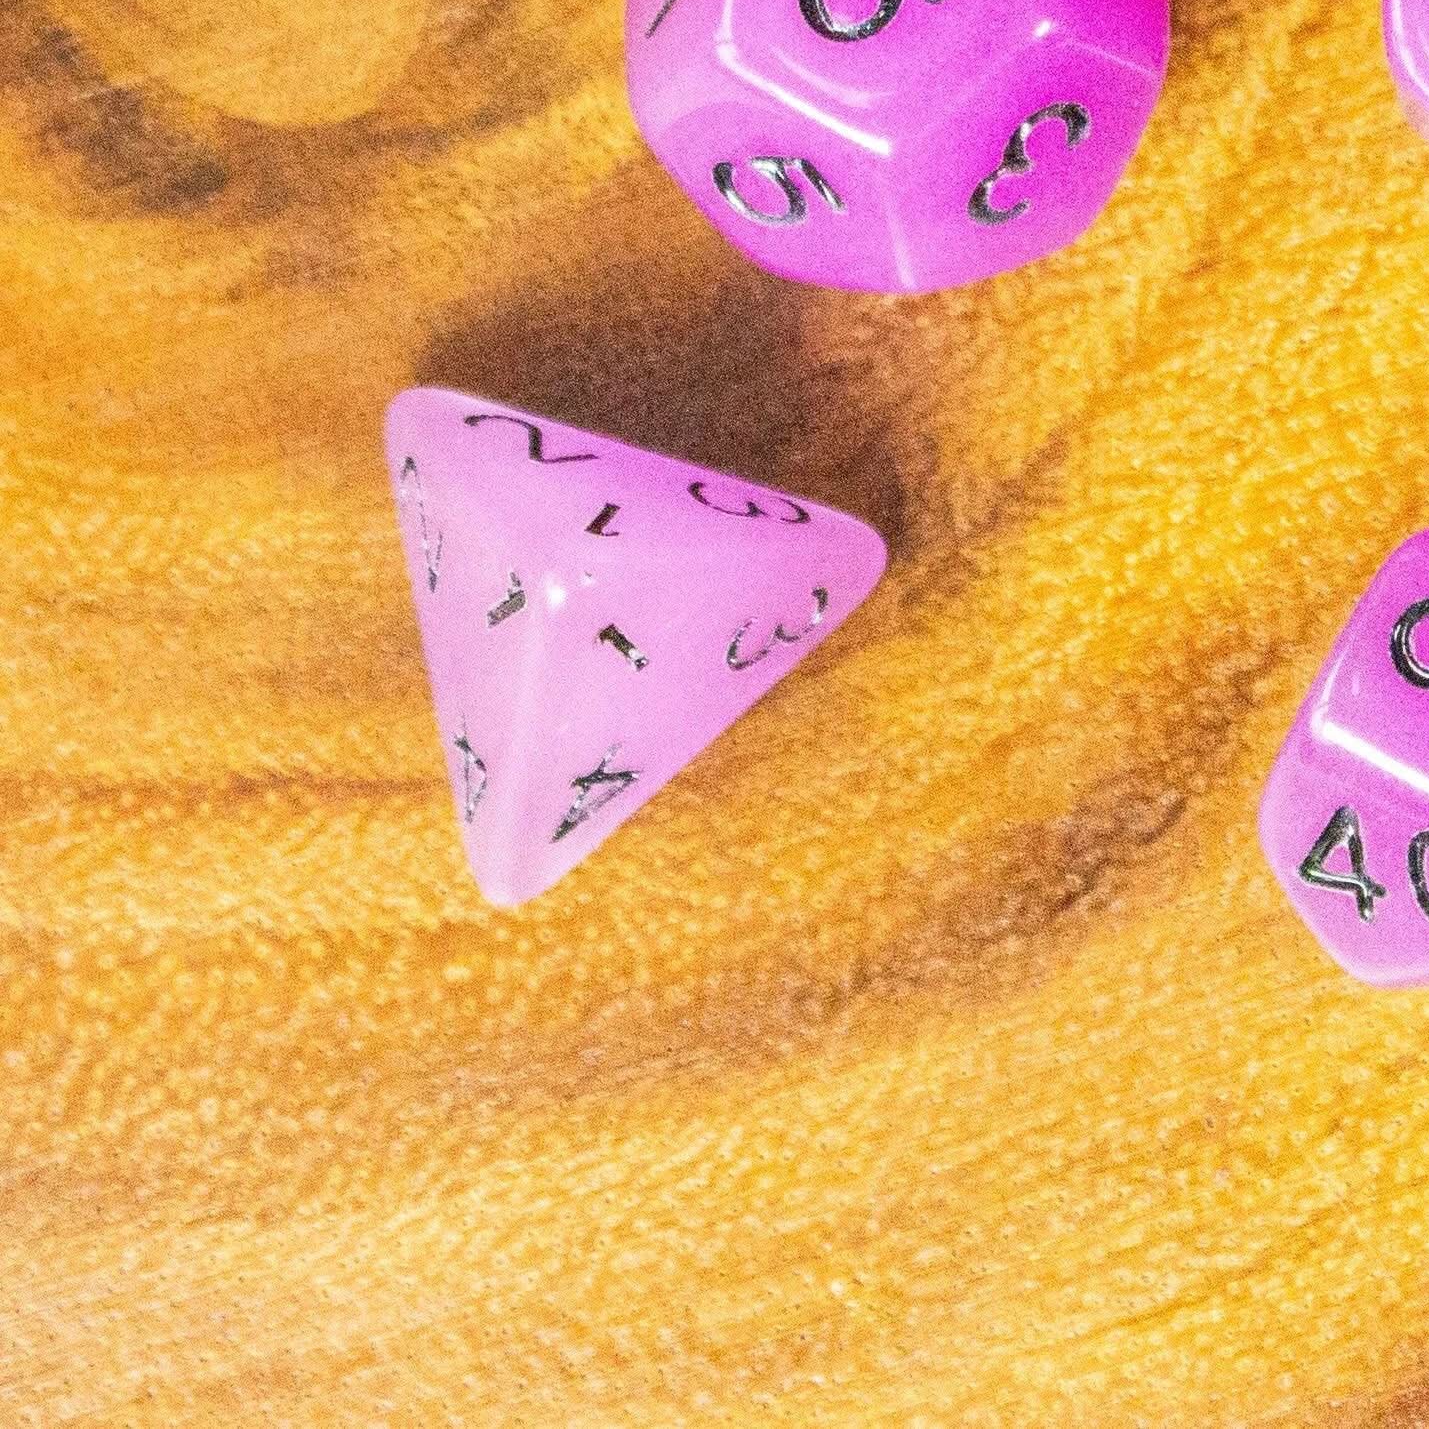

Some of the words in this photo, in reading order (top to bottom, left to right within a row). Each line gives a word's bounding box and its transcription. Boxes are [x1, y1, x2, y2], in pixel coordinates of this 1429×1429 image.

[967, 101, 1091, 225] 3
[464, 413, 600, 464] 2
[687, 481, 811, 524] 3
[725, 585, 828, 671] 3
[551, 743, 643, 844] 4
